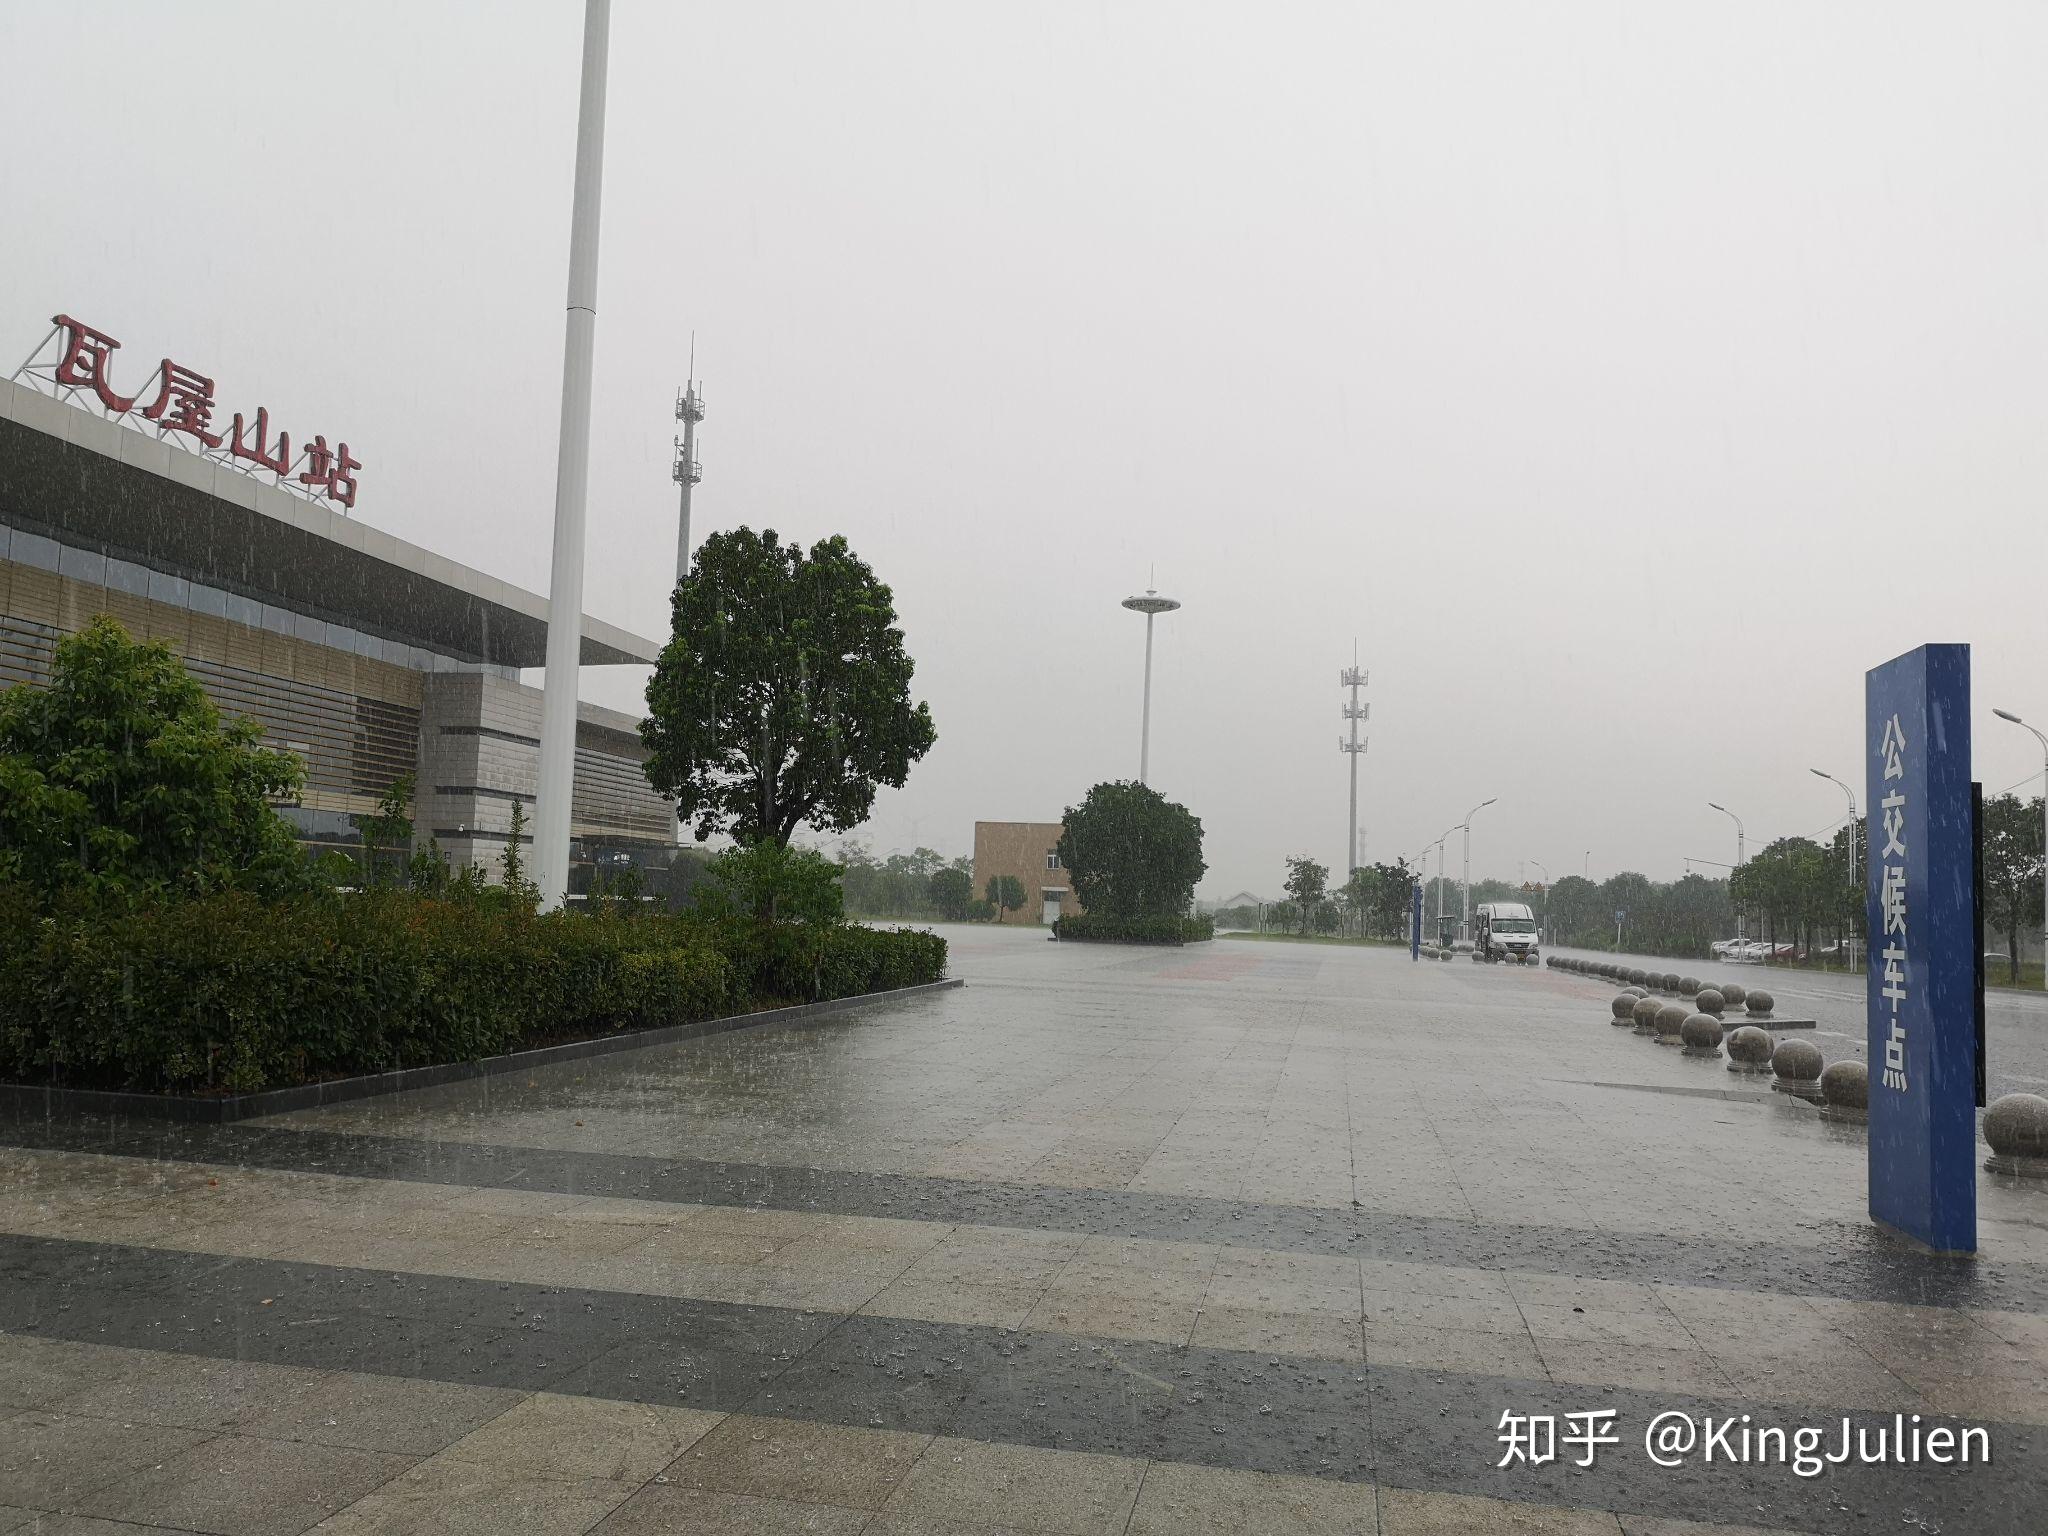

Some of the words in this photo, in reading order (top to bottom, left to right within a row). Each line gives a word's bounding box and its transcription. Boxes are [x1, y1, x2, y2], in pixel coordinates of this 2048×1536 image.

[51, 313, 362, 508] 瓦屋山站
[1881, 713, 1907, 1093] 公交候车点
